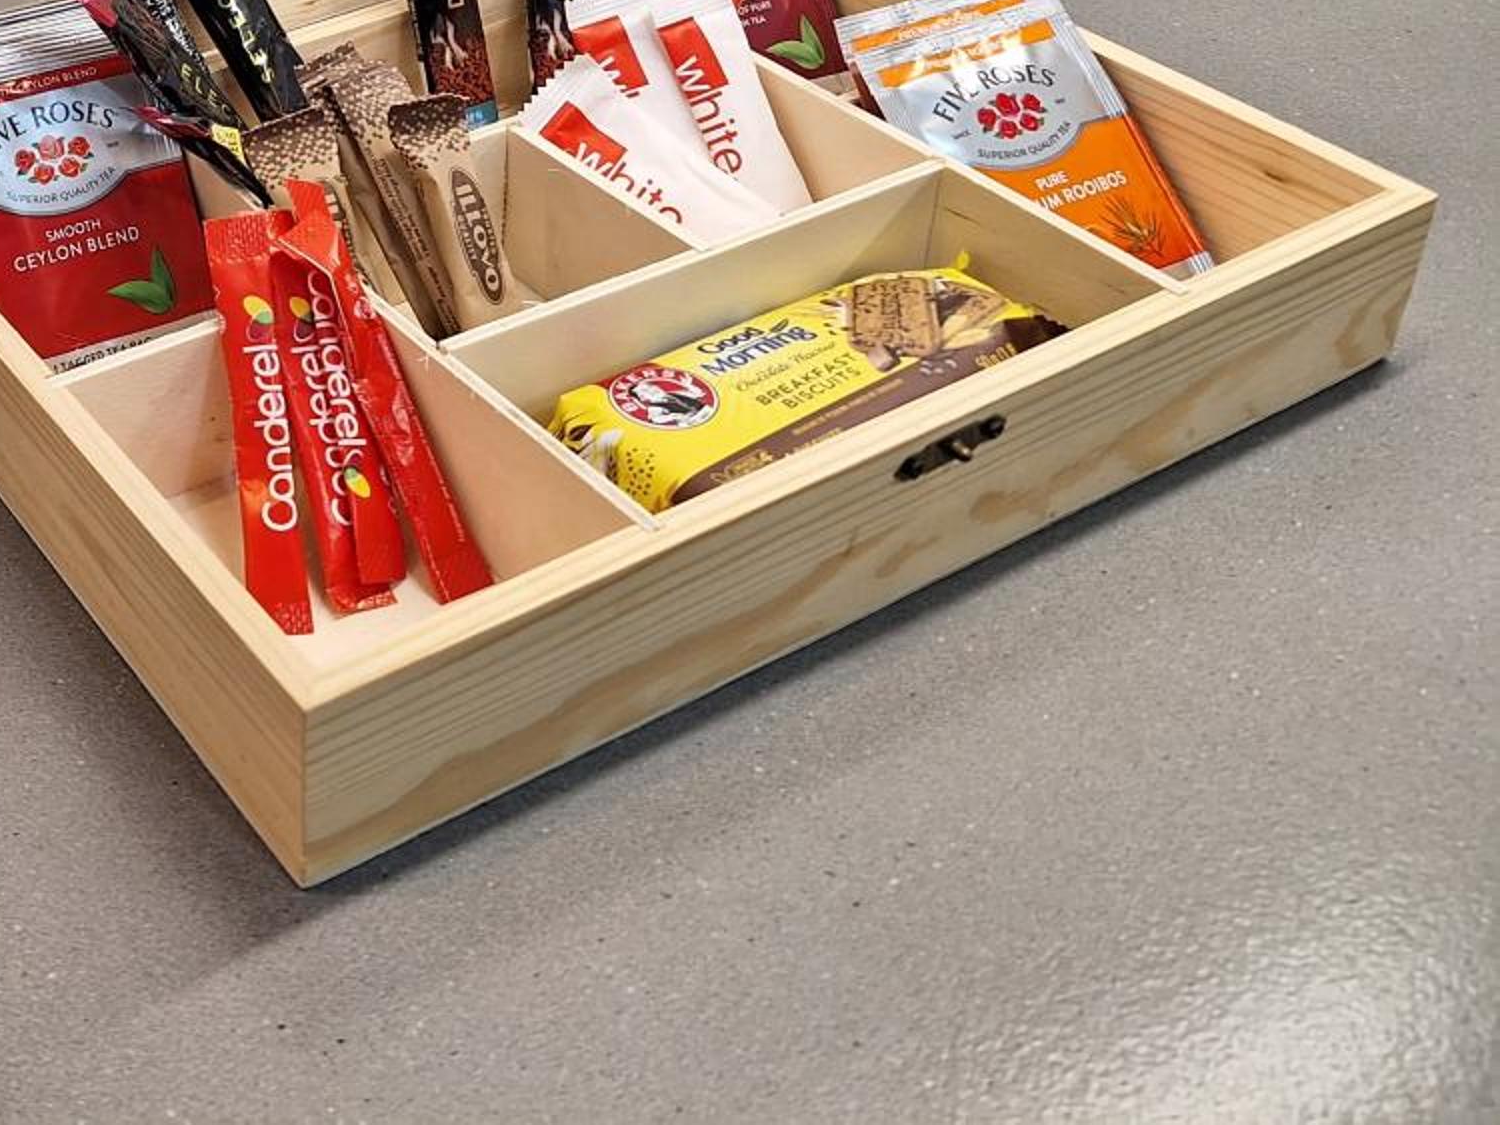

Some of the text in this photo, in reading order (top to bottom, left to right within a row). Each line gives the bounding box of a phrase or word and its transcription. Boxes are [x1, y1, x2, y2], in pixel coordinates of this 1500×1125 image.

[61, 66, 98, 84] BLEND
[980, 63, 1056, 89] ROSES
[31, 100, 116, 132] ROSES
[675, 55, 744, 176] white
[977, 120, 1073, 160] SUPERIOR QUALITY TEA
[6, 165, 118, 205] SUPERIOR QUALITY TEA
[1035, 170, 1069, 192] PURE
[1064, 170, 1128, 205] ROOIBOS
[13, 225, 141, 273] CEYLON BLEND
[45, 220, 102, 243] SMOOTH
[696, 324, 767, 356] Good
[704, 325, 819, 379] Morning
[754, 352, 858, 407] BREAKFAST
[781, 365, 863, 411] BISCUITS
[243, 343, 299, 532] Canderel
